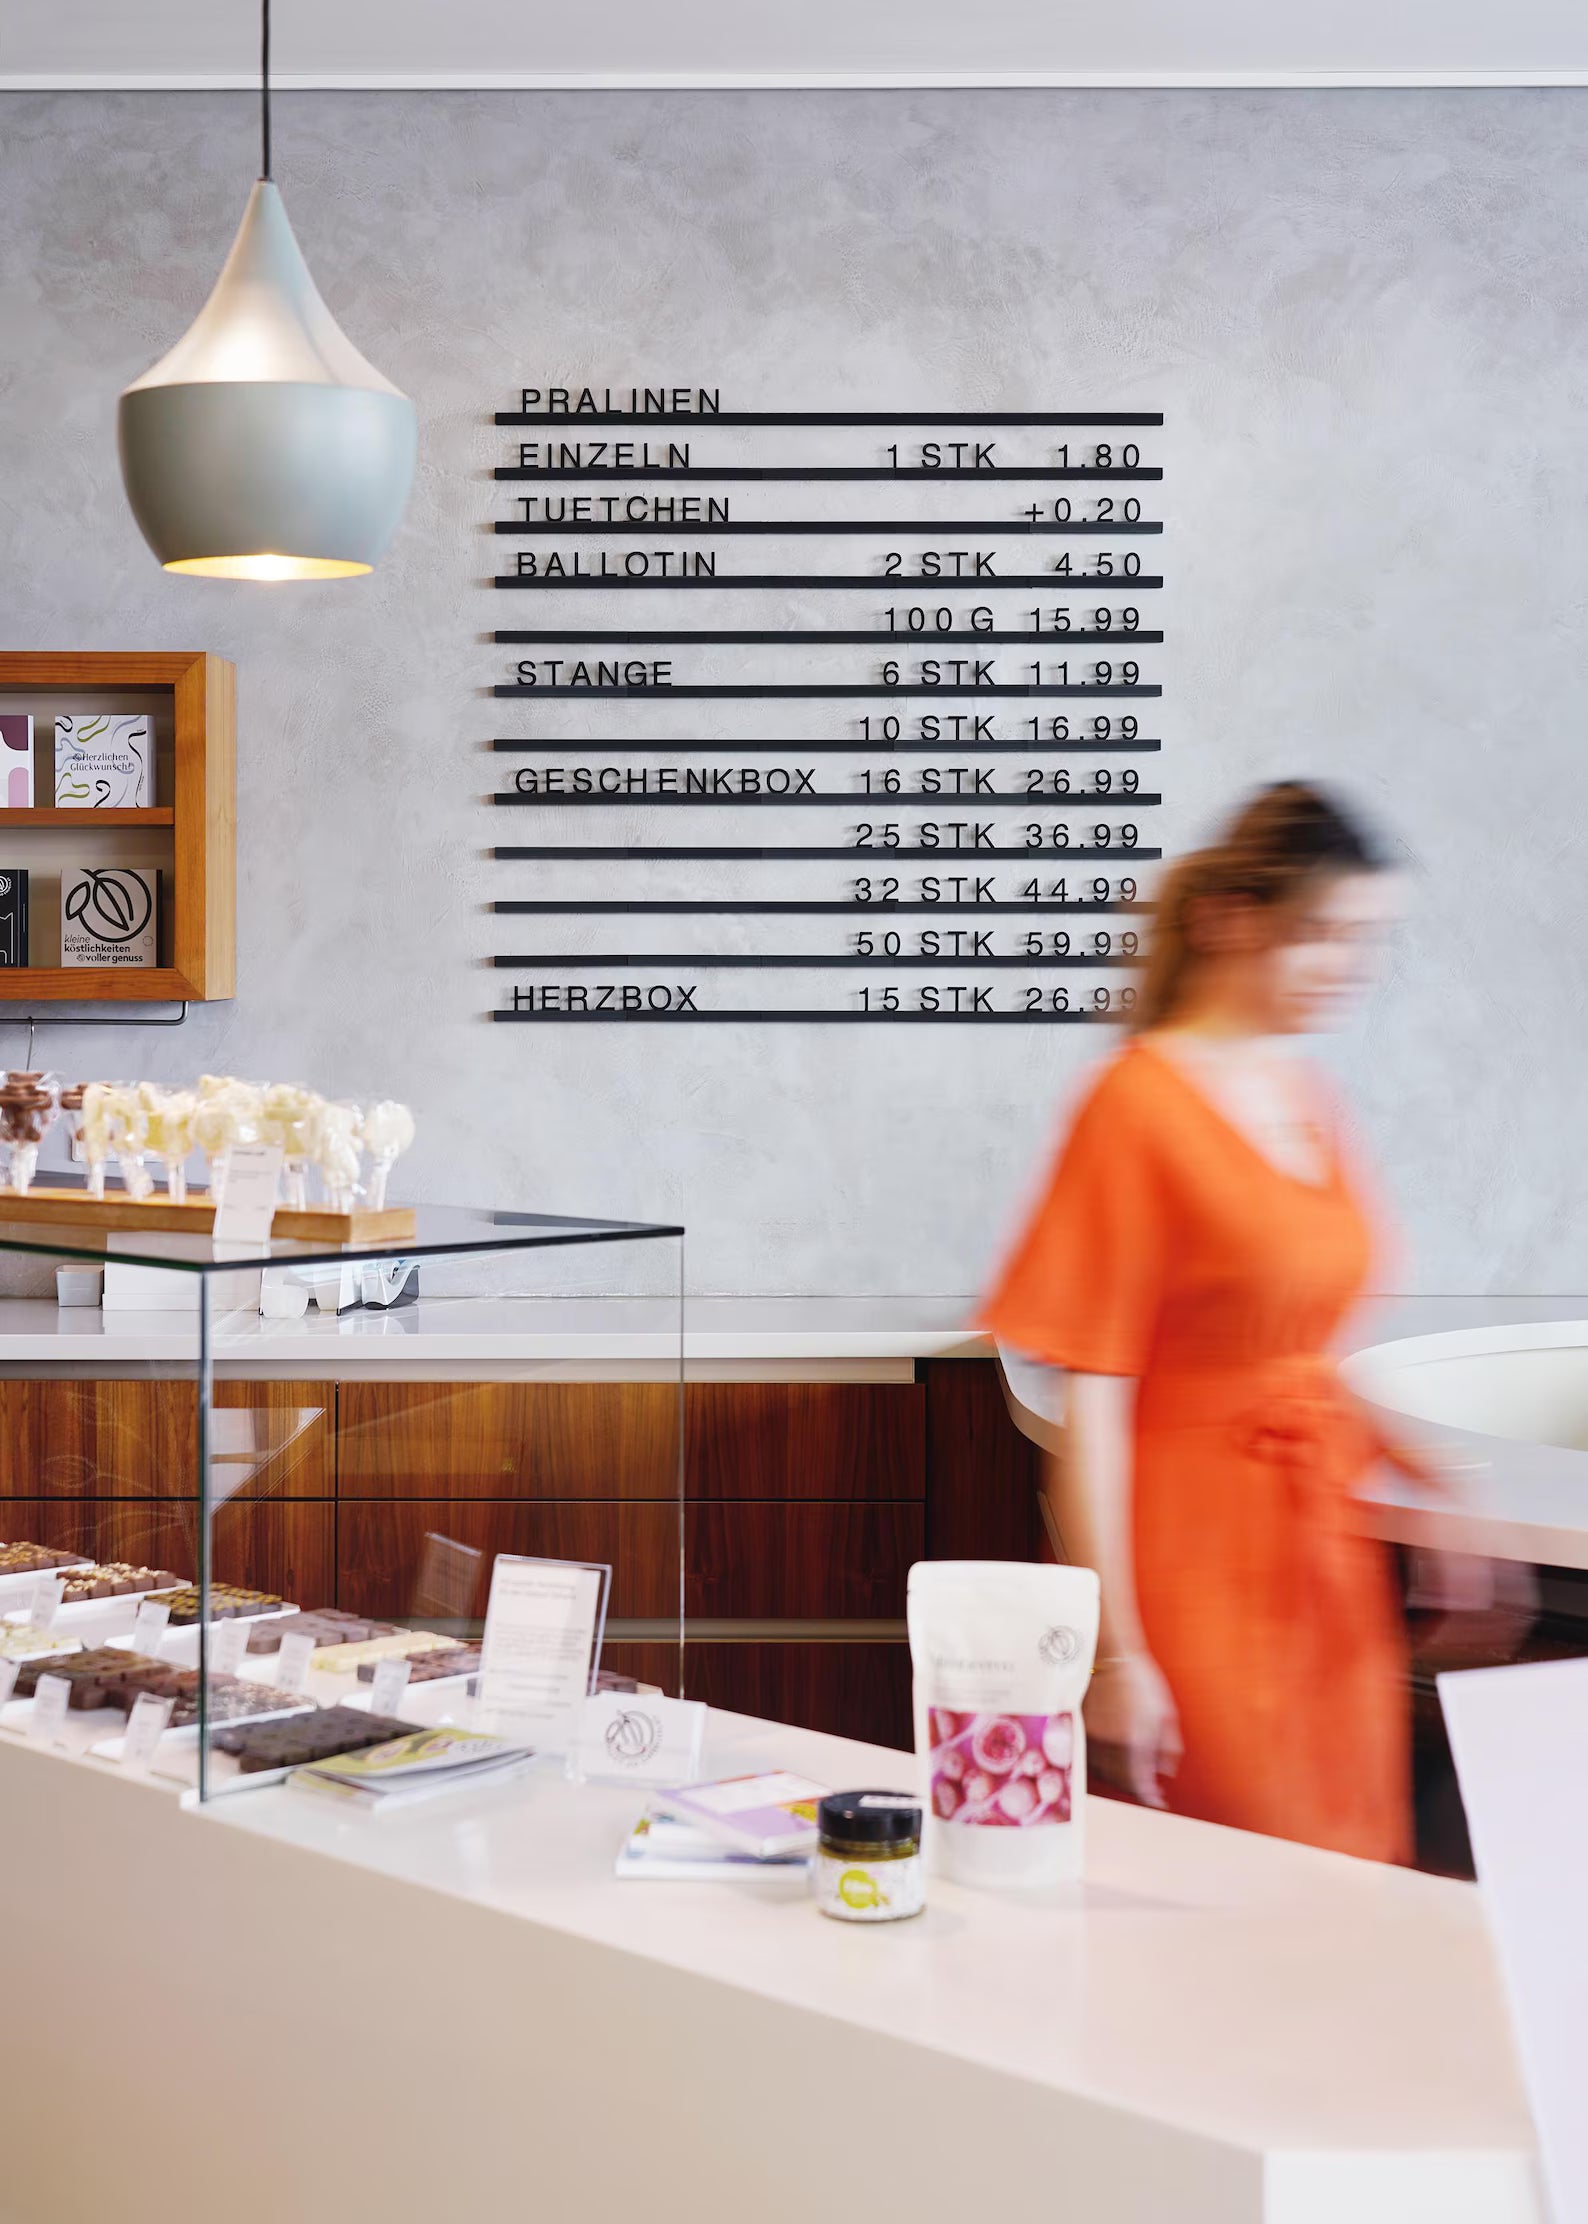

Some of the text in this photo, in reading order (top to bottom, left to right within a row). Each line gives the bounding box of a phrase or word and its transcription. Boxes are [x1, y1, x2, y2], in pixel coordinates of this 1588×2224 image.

[521, 388, 720, 414] PRALINEN
[520, 443, 1140, 468] EINZELN 1 STK 1.80
[518, 496, 1141, 523] TUETCHEN +0.20
[517, 551, 1141, 577] BALLOTIN 2 STK 4.50
[884, 606, 1140, 632] 100 G 15.99
[517, 660, 1140, 686] STANGE 6 STK 11.99
[859, 715, 1139, 741] 10 STK 16.99
[82, 752, 129, 761] Herzlichen
[515, 768, 1139, 794] GESCHENKBOX 16 STK 26.99
[856, 823, 1139, 849] 25 STK 36.99
[854, 877, 1137, 903] 32 STK 44.99
[64, 934, 91, 943] kleine
[64, 943, 131, 953] köstlichkeiten
[856, 931, 1139, 957] 50 STK 59.99
[85, 953, 144, 964] voller genuss
[513, 985, 1138, 1013] HERZBOX 15 STK 26.99
